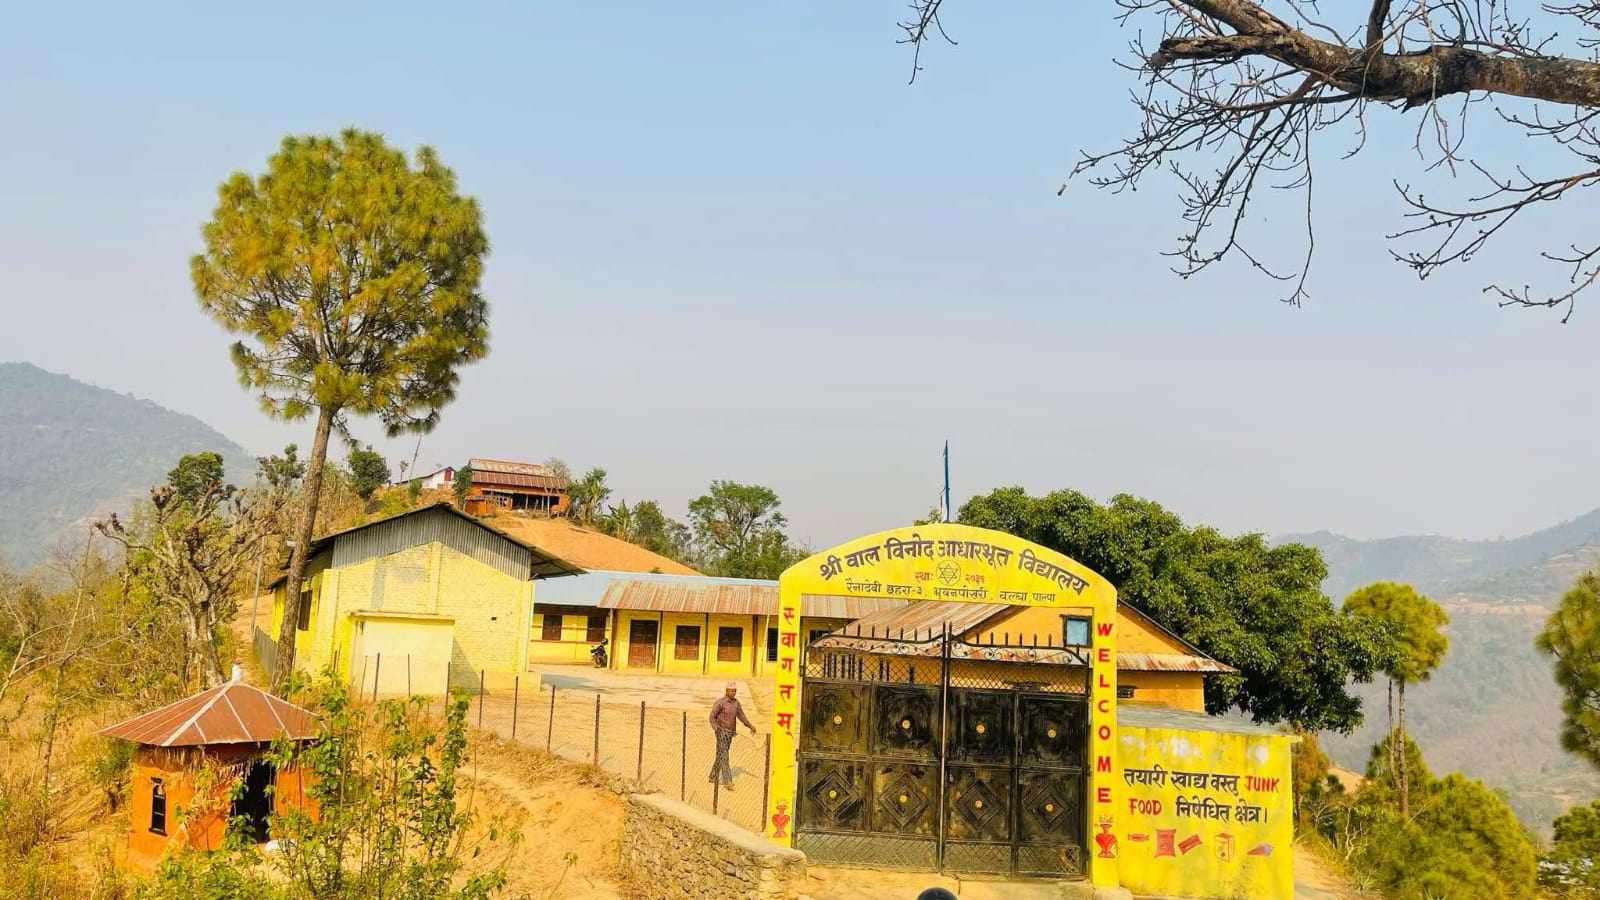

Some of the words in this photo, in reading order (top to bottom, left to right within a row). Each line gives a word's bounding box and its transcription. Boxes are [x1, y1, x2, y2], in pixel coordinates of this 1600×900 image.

[820, 555, 843, 580] श्री
[883, 533, 934, 560] विनोद
[937, 540, 1013, 569] आधारभूत
[1018, 549, 1089, 595] विद्यालय
[1096, 623, 1113, 803] WELCOME
[1124, 764, 1168, 788] तयारी
[1211, 774, 1240, 796] वस्तु
[1246, 775, 1280, 793] JUNK
[1128, 798, 1162, 816] FOOD
[1176, 795, 1232, 824] निषेधित
